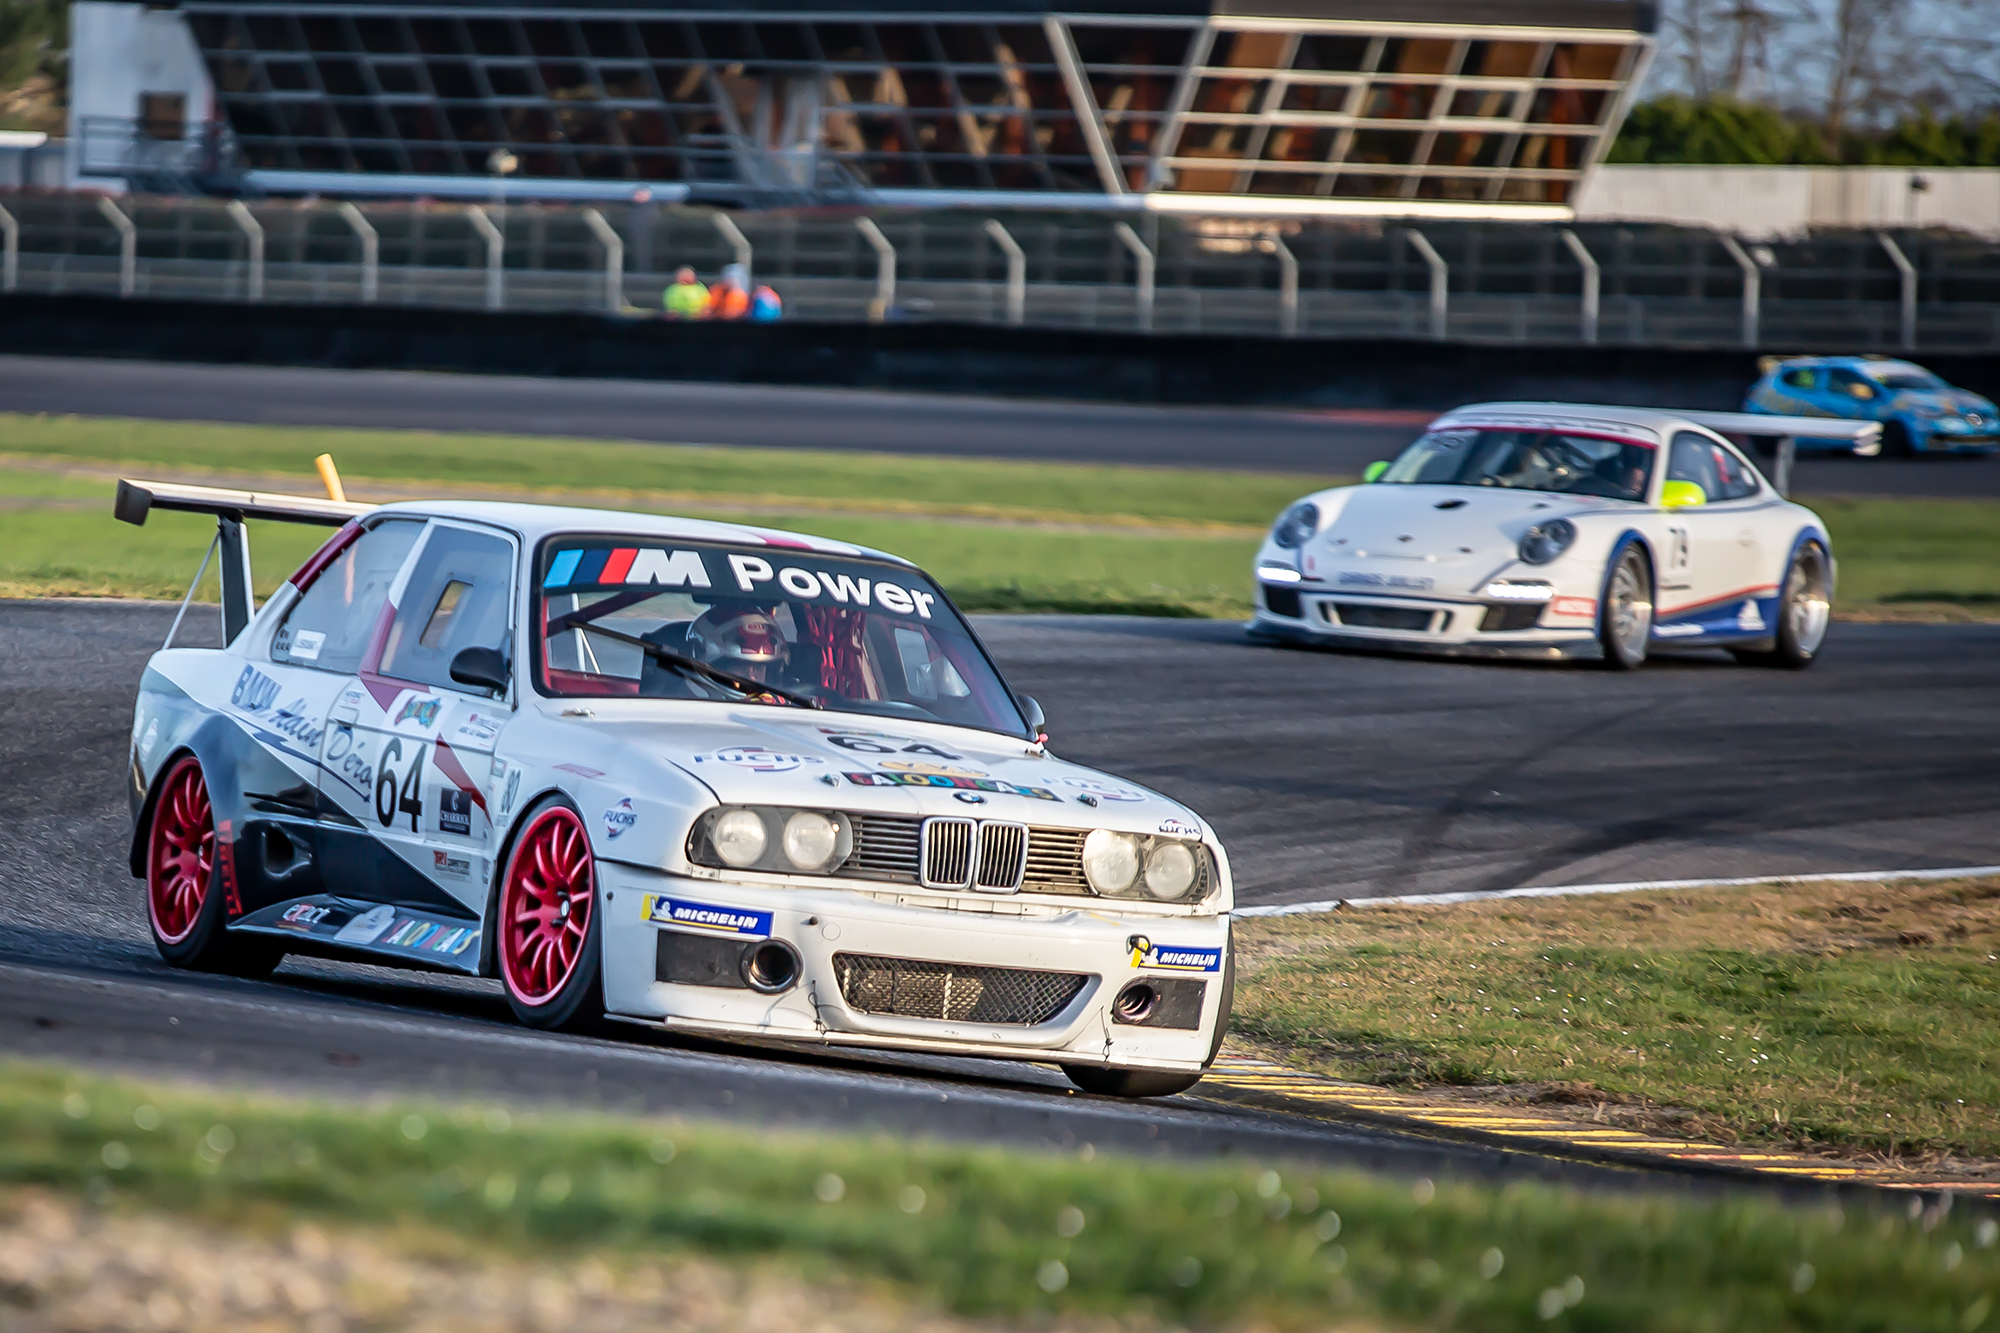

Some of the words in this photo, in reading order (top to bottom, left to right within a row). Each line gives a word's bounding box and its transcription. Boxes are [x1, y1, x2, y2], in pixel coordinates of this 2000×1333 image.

[625, 548, 711, 588] M
[727, 553, 935, 620] Power
[231, 664, 282, 710] BMW
[693, 752, 825, 764] FUCHS
[827, 736, 964, 760] 64
[376, 737, 428, 834] 64
[603, 809, 637, 825] FUCHS
[1158, 825, 1200, 835] FUCHS
[674, 907, 759, 929] MICHELIN
[1160, 952, 1218, 967] MICHELIN
